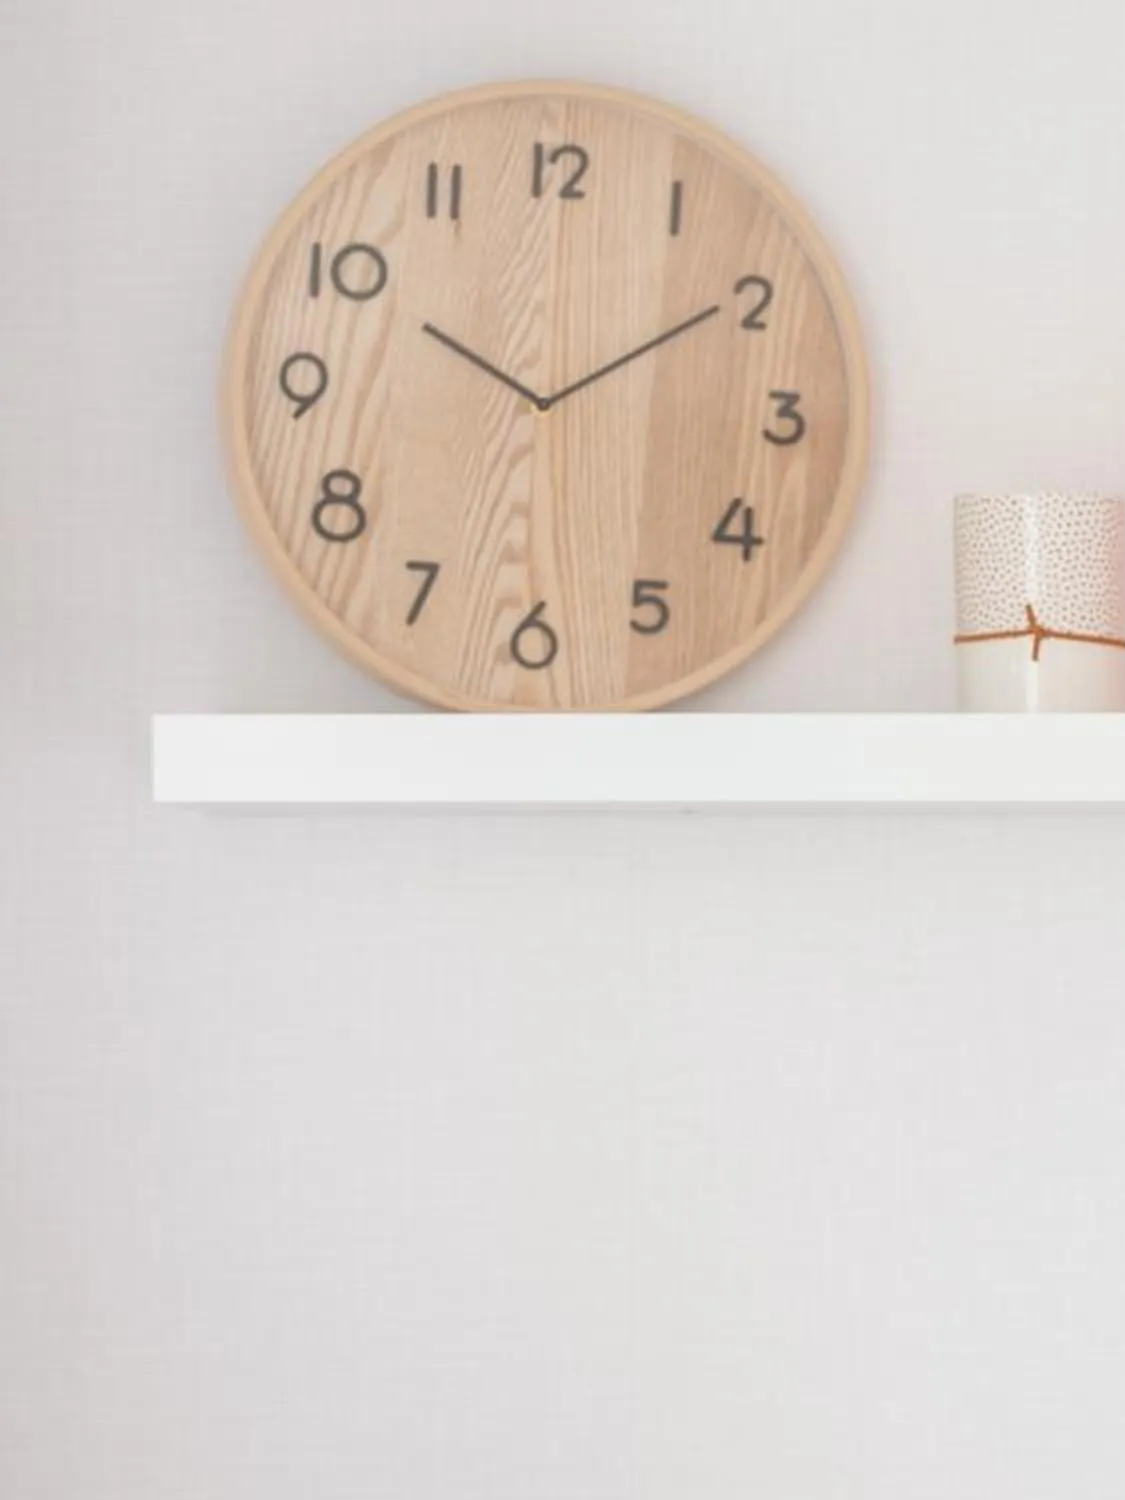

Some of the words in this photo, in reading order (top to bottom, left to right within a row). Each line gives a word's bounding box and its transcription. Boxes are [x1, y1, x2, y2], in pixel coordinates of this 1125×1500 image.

[425, 162, 463, 221] 11
[529, 142, 590, 200] 12
[669, 180, 683, 237] 1
[309, 242, 389, 301] 10
[733, 274, 774, 331] 2
[279, 352, 329, 420] 9
[761, 390, 807, 447] 3
[310, 469, 368, 544] 8
[710, 497, 764, 563] 4
[405, 560, 441, 626] 7
[629, 579, 671, 636] 5
[509, 600, 559, 671] 6
